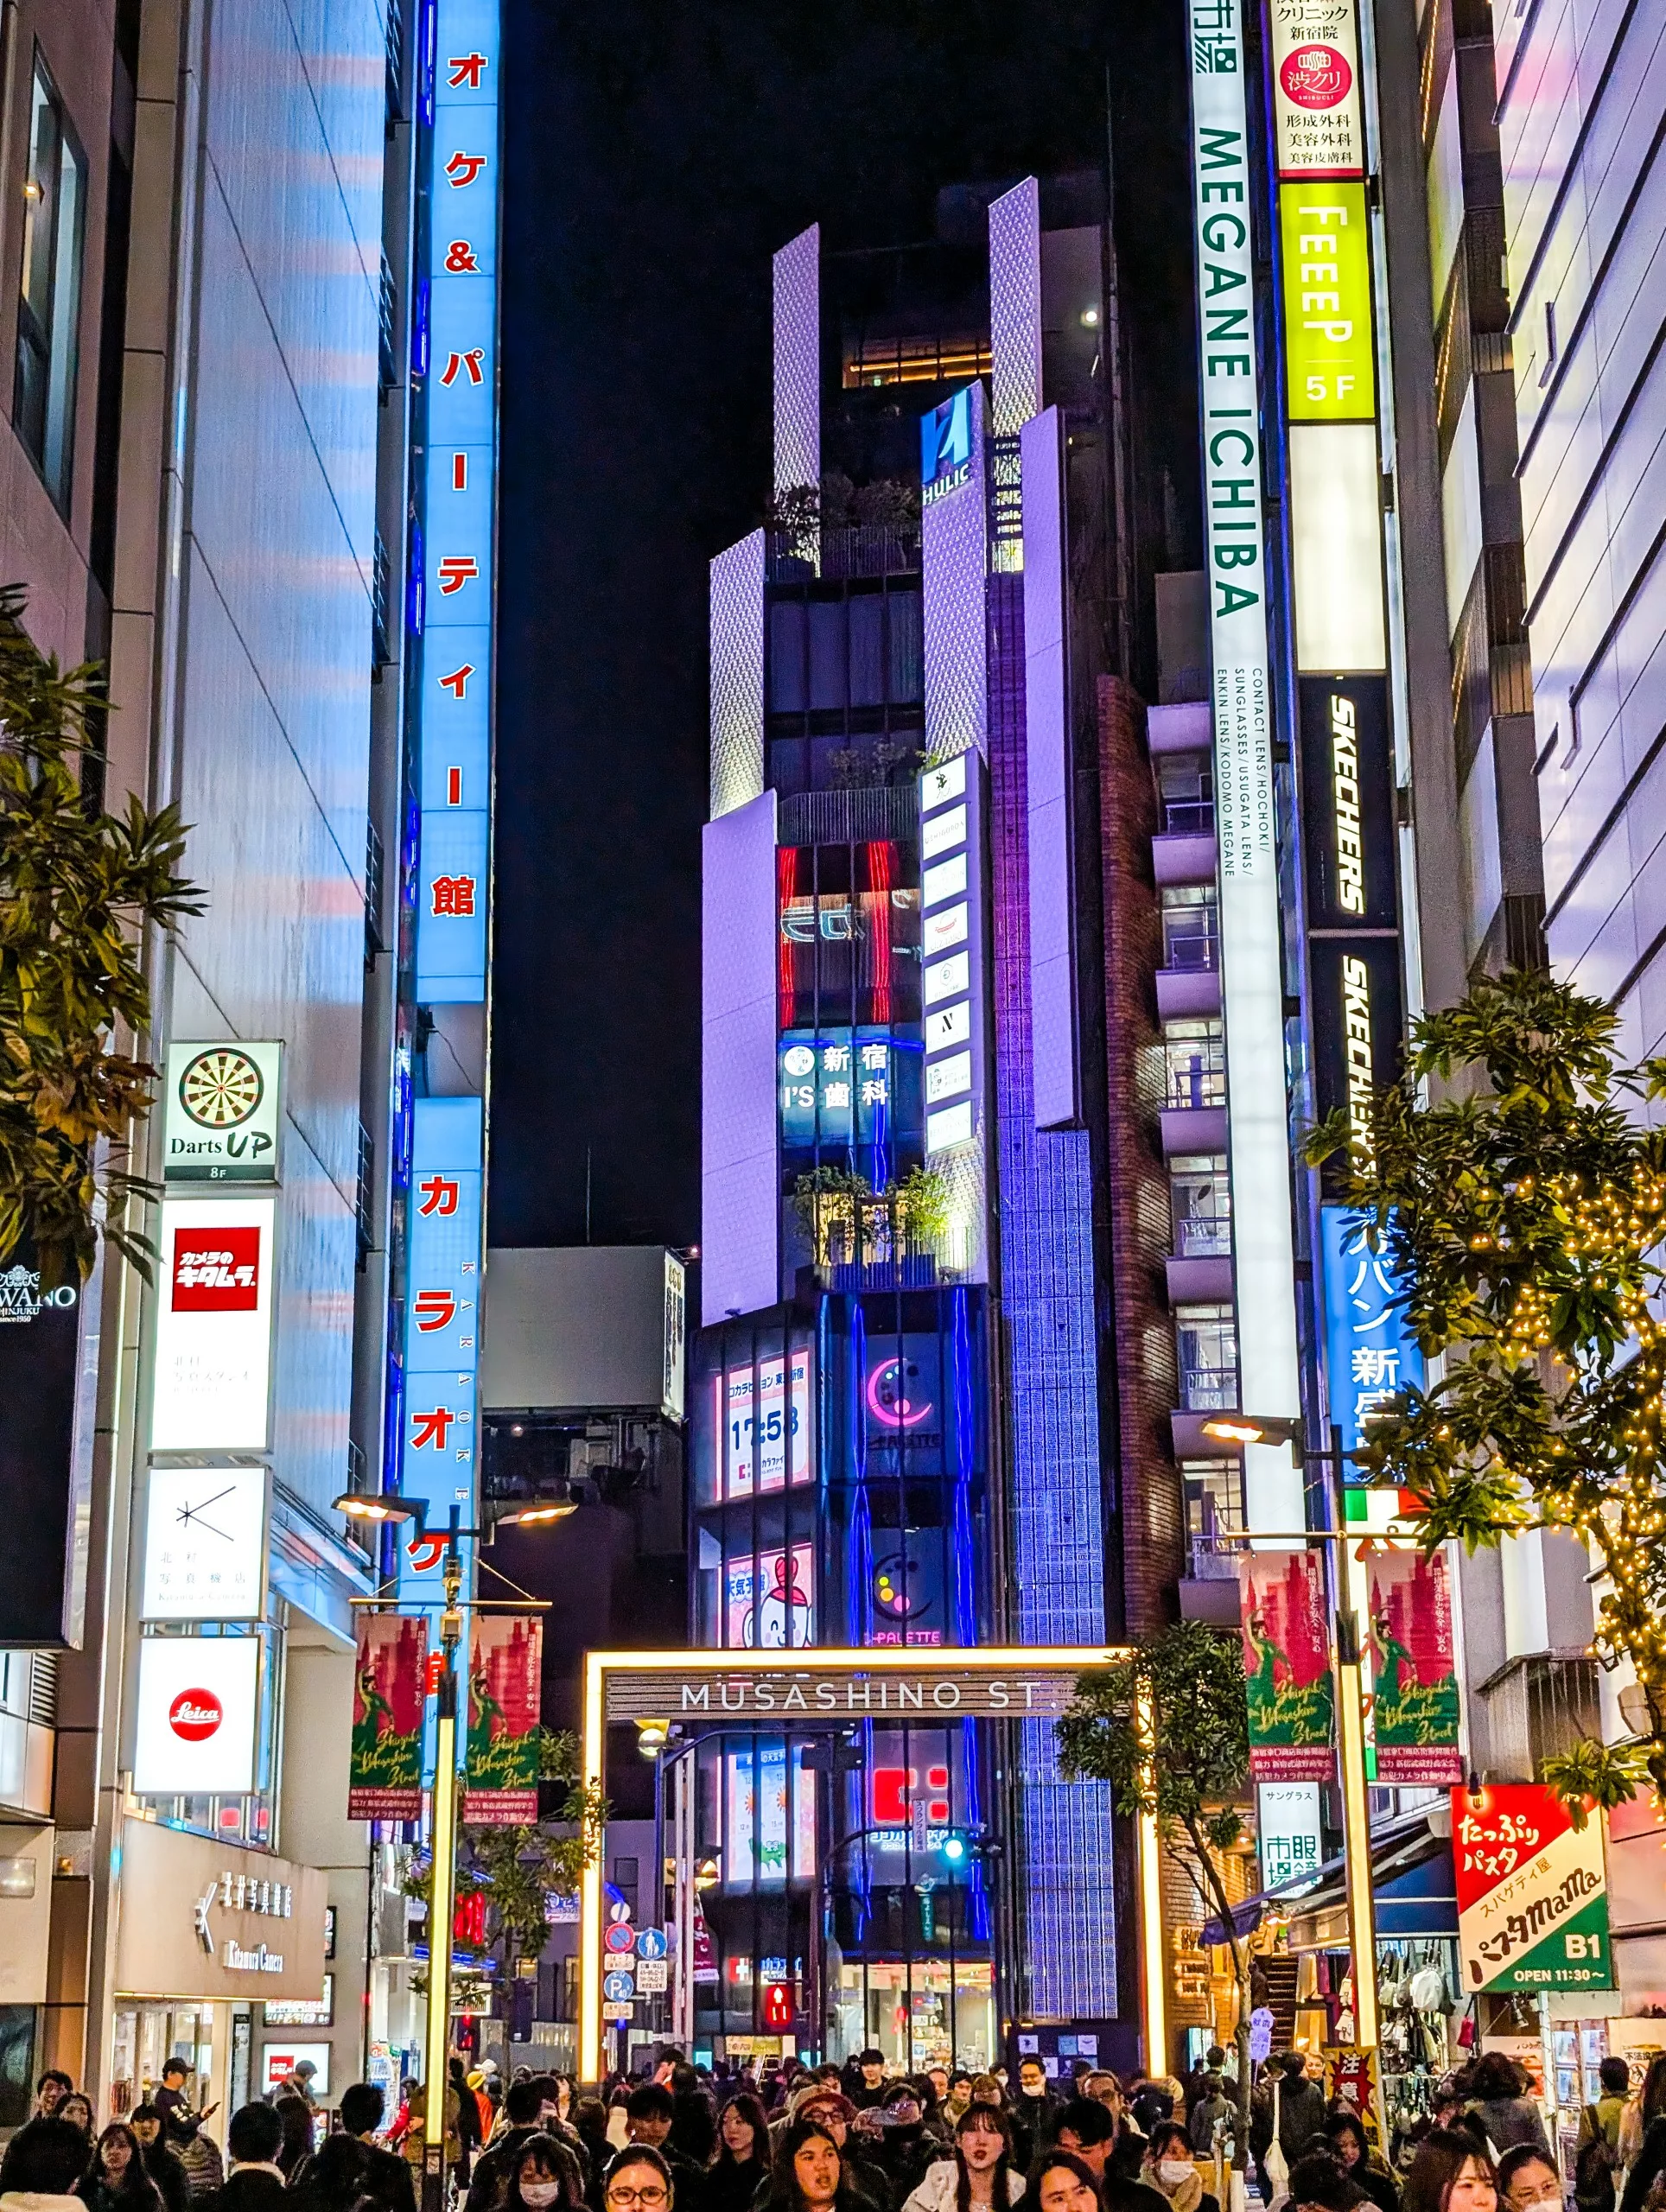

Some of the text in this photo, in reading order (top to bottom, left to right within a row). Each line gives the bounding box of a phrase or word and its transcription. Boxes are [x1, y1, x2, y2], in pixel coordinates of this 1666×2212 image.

[1276, 6, 1348, 23] クリニック
[1290, 26, 1339, 41] 新宿院
[1288, 69, 1344, 94] 渋クリ
[1287, 114, 1351, 128] 形成外科
[1287, 132, 1352, 147] 美容外科
[1288, 151, 1353, 164] 美容皮膚科
[1298, 206, 1354, 344] FEEEP
[1199, 127, 1260, 619] MEGANE ICHIBA
[1307, 375, 1356, 401] 5F
[922, 463, 970, 506] HULIC
[1218, 668, 1235, 877] ENKIN LENS/KODOMO MEGANE
[1235, 667, 1254, 876] SUNGLASSES/USUGATA LENS/
[1252, 667, 1270, 853] CONTACT LENS/HOCHOKI/
[1332, 694, 1366, 915] SKECHERS
[824, 1043, 888, 1072] 新宿
[170, 1131, 273, 1160] Darts UP
[210, 1166, 227, 1179] 8F
[179, 1251, 234, 1266] カメラの
[454, 1261, 477, 1501] KARAOKE
[775, 1367, 804, 1386] 東新宿
[681, 1681, 1059, 1712] MUSASHINO ST.
[169, 1700, 220, 1725] Leica
[1266, 1791, 1313, 1801] サングラス
[1458, 1814, 1540, 1847] たっぷり
[1463, 1847, 1518, 1876] パスタ
[1479, 1858, 1553, 1918] スパゲティ屋
[227, 1940, 284, 1973] Kitamura Camera
[1565, 1934, 1601, 1960] B1
[1514, 1969, 1552, 1982] OPEN
[1340, 2052, 1362, 2103] 注意
